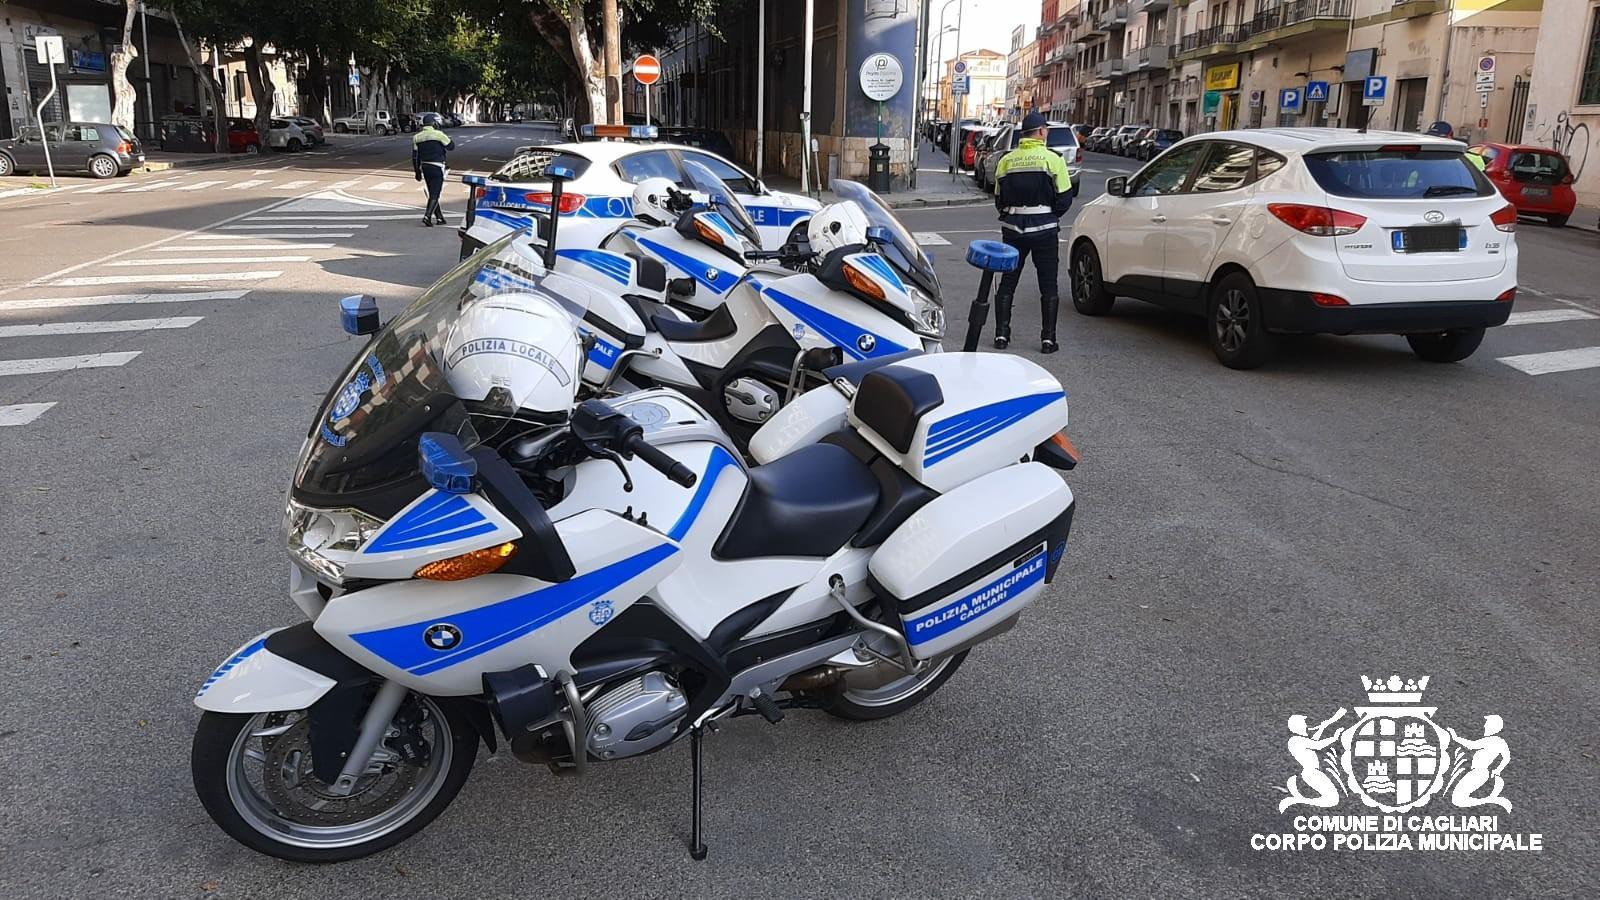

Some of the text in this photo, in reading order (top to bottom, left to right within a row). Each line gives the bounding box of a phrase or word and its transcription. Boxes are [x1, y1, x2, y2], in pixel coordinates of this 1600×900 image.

[1284, 91, 1297, 107] P
[1368, 78, 1383, 96] P
[462, 341, 555, 370] POLIZIA LOCALE
[916, 558, 1043, 632] POLIZIA MUNICIPALE
[960, 591, 1007, 621] CAGLIARI
